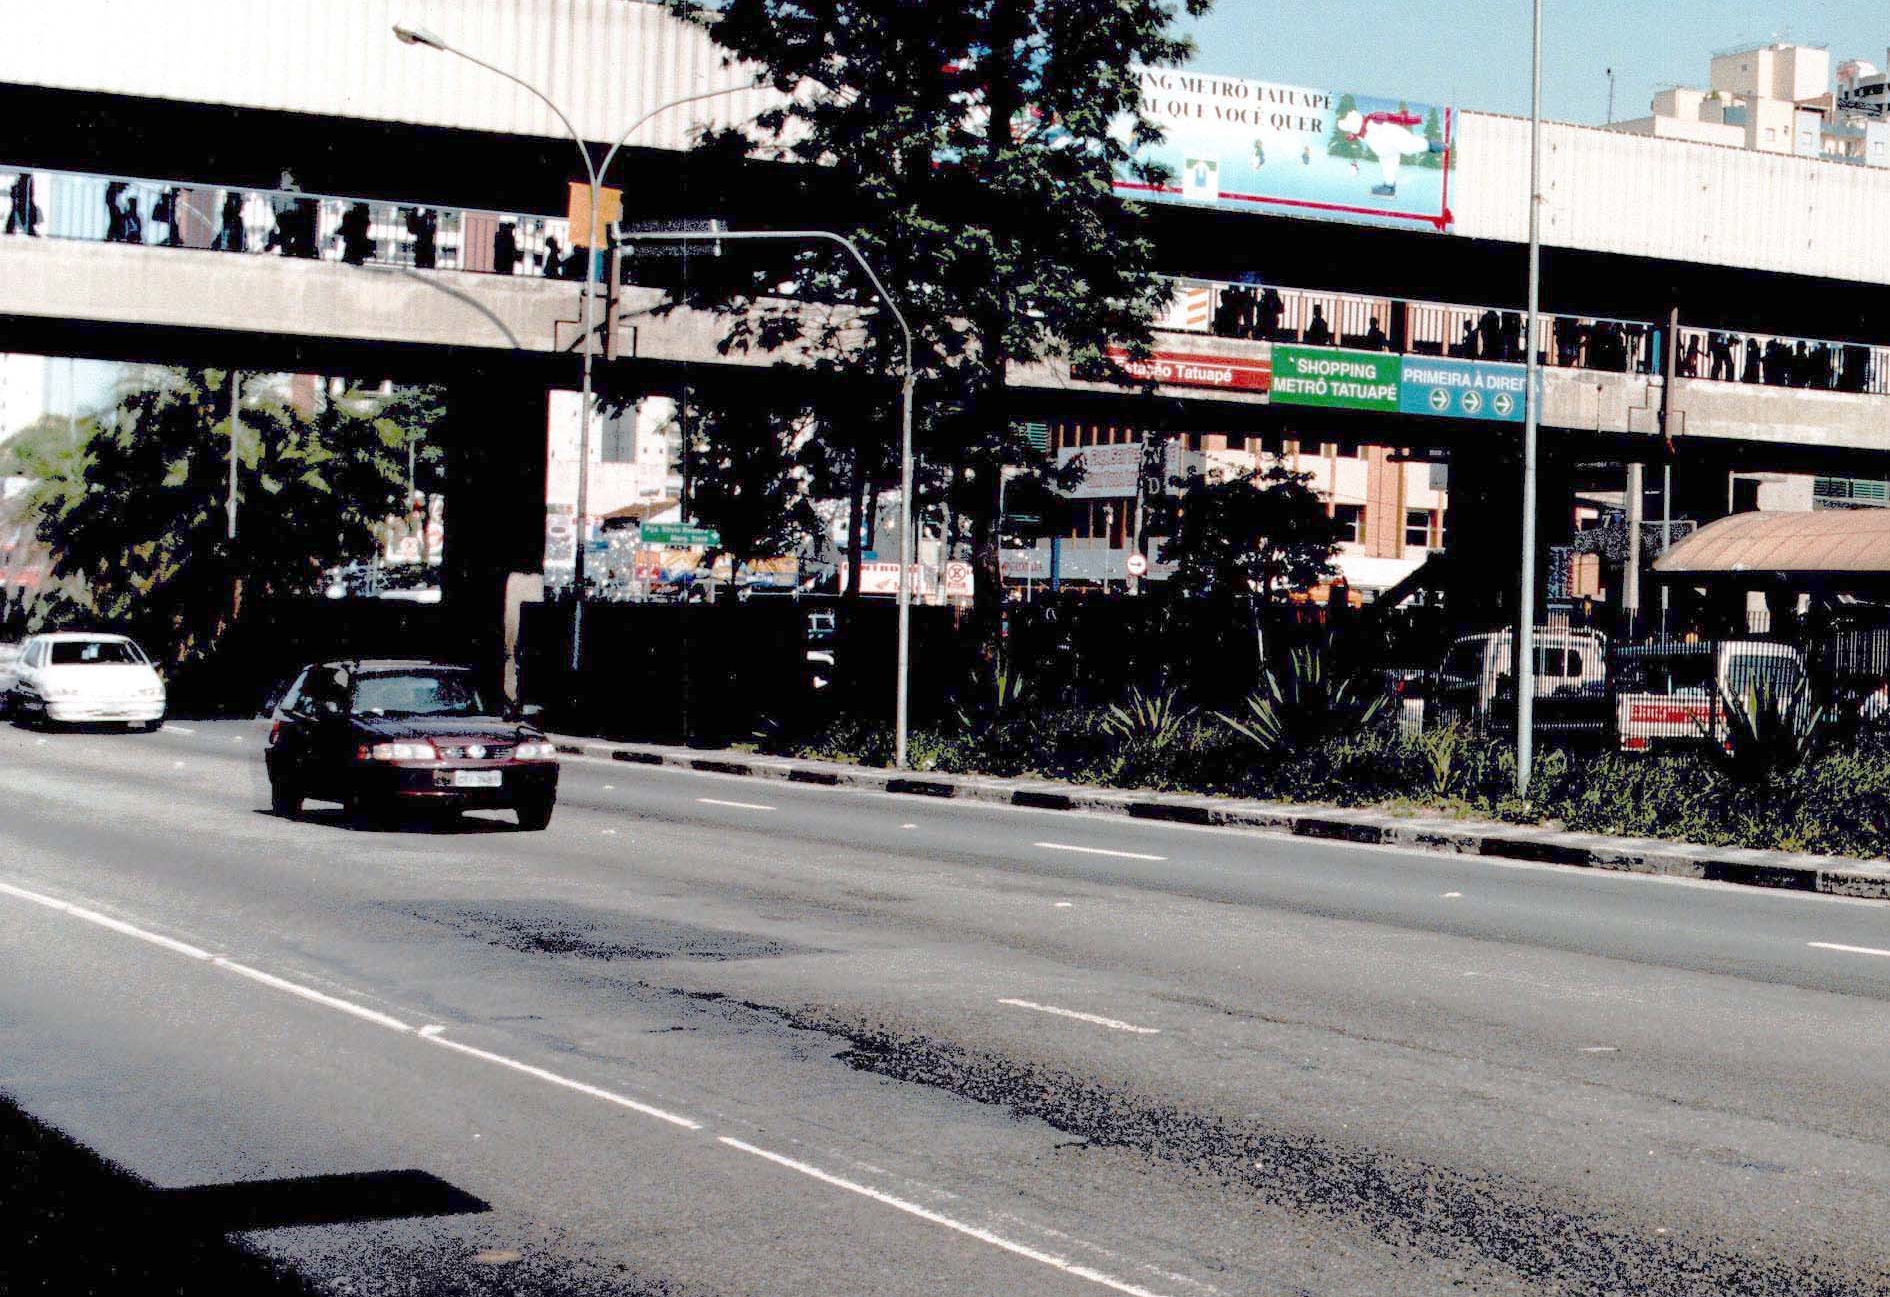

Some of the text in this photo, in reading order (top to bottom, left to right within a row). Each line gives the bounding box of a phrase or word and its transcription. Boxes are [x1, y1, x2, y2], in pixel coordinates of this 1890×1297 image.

[1180, 76, 1249, 99] METRÔ
[1256, 85, 1334, 110] TATUAPÉ
[1167, 100, 1204, 119] QUE
[1214, 105, 1262, 126] VOCÊ
[1270, 112, 1323, 133] QUER
[1176, 364, 1233, 384] Tatuapé
[1296, 358, 1377, 380] SHOPPING
[1402, 367, 1540, 393] PRIMEIRA À DIREI
[1273, 376, 1398, 402] METRÔ TATUAPÉ
